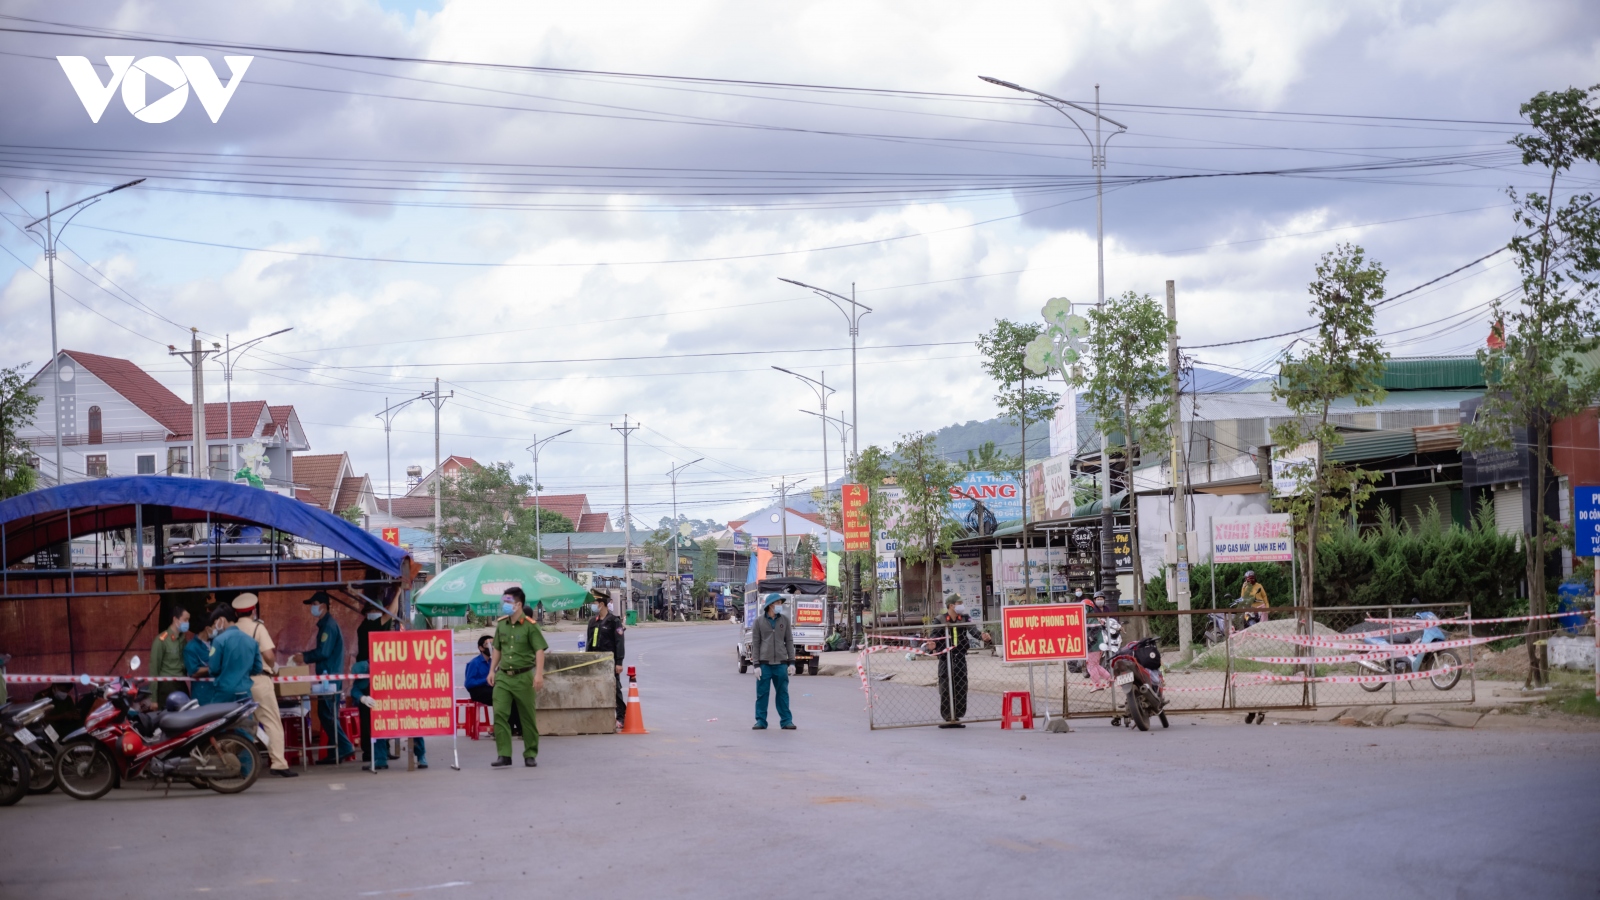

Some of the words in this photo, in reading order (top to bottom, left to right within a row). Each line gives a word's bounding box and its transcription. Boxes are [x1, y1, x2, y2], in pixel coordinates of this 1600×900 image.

[950, 484, 1016, 499] SANG
[1580, 510, 1588, 520] DO
[1216, 544, 1226, 555] NẠP
[1228, 544, 1238, 552] GAS
[1240, 541, 1250, 552] MÁY
[1254, 543, 1268, 554] LẠNH
[431, 606, 456, 614] Coffee
[552, 597, 574, 608] Coffee
[1010, 617, 1023, 628] KHU
[1025, 615, 1039, 630] VỰC
[1041, 615, 1064, 627] PHONG
[1066, 611, 1080, 626] TOẢ
[373, 641, 408, 662] KHU
[412, 636, 447, 664] VỰC
[1010, 634, 1036, 655] CẤM
[1039, 638, 1055, 654] RA
[1058, 634, 1081, 653] VÀO
[372, 671, 392, 691] GIÃN
[395, 670, 418, 690] CÁCH
[420, 669, 432, 689] XÃ
[434, 668, 449, 691] HỘI
[419, 698, 429, 711] Ngày
[430, 697, 452, 709] 31/3/2020
[374, 714, 386, 731] CỦA
[387, 714, 398, 730] THỦ
[420, 714, 437, 729] CHÍNH
[438, 712, 450, 728] PHỦ
